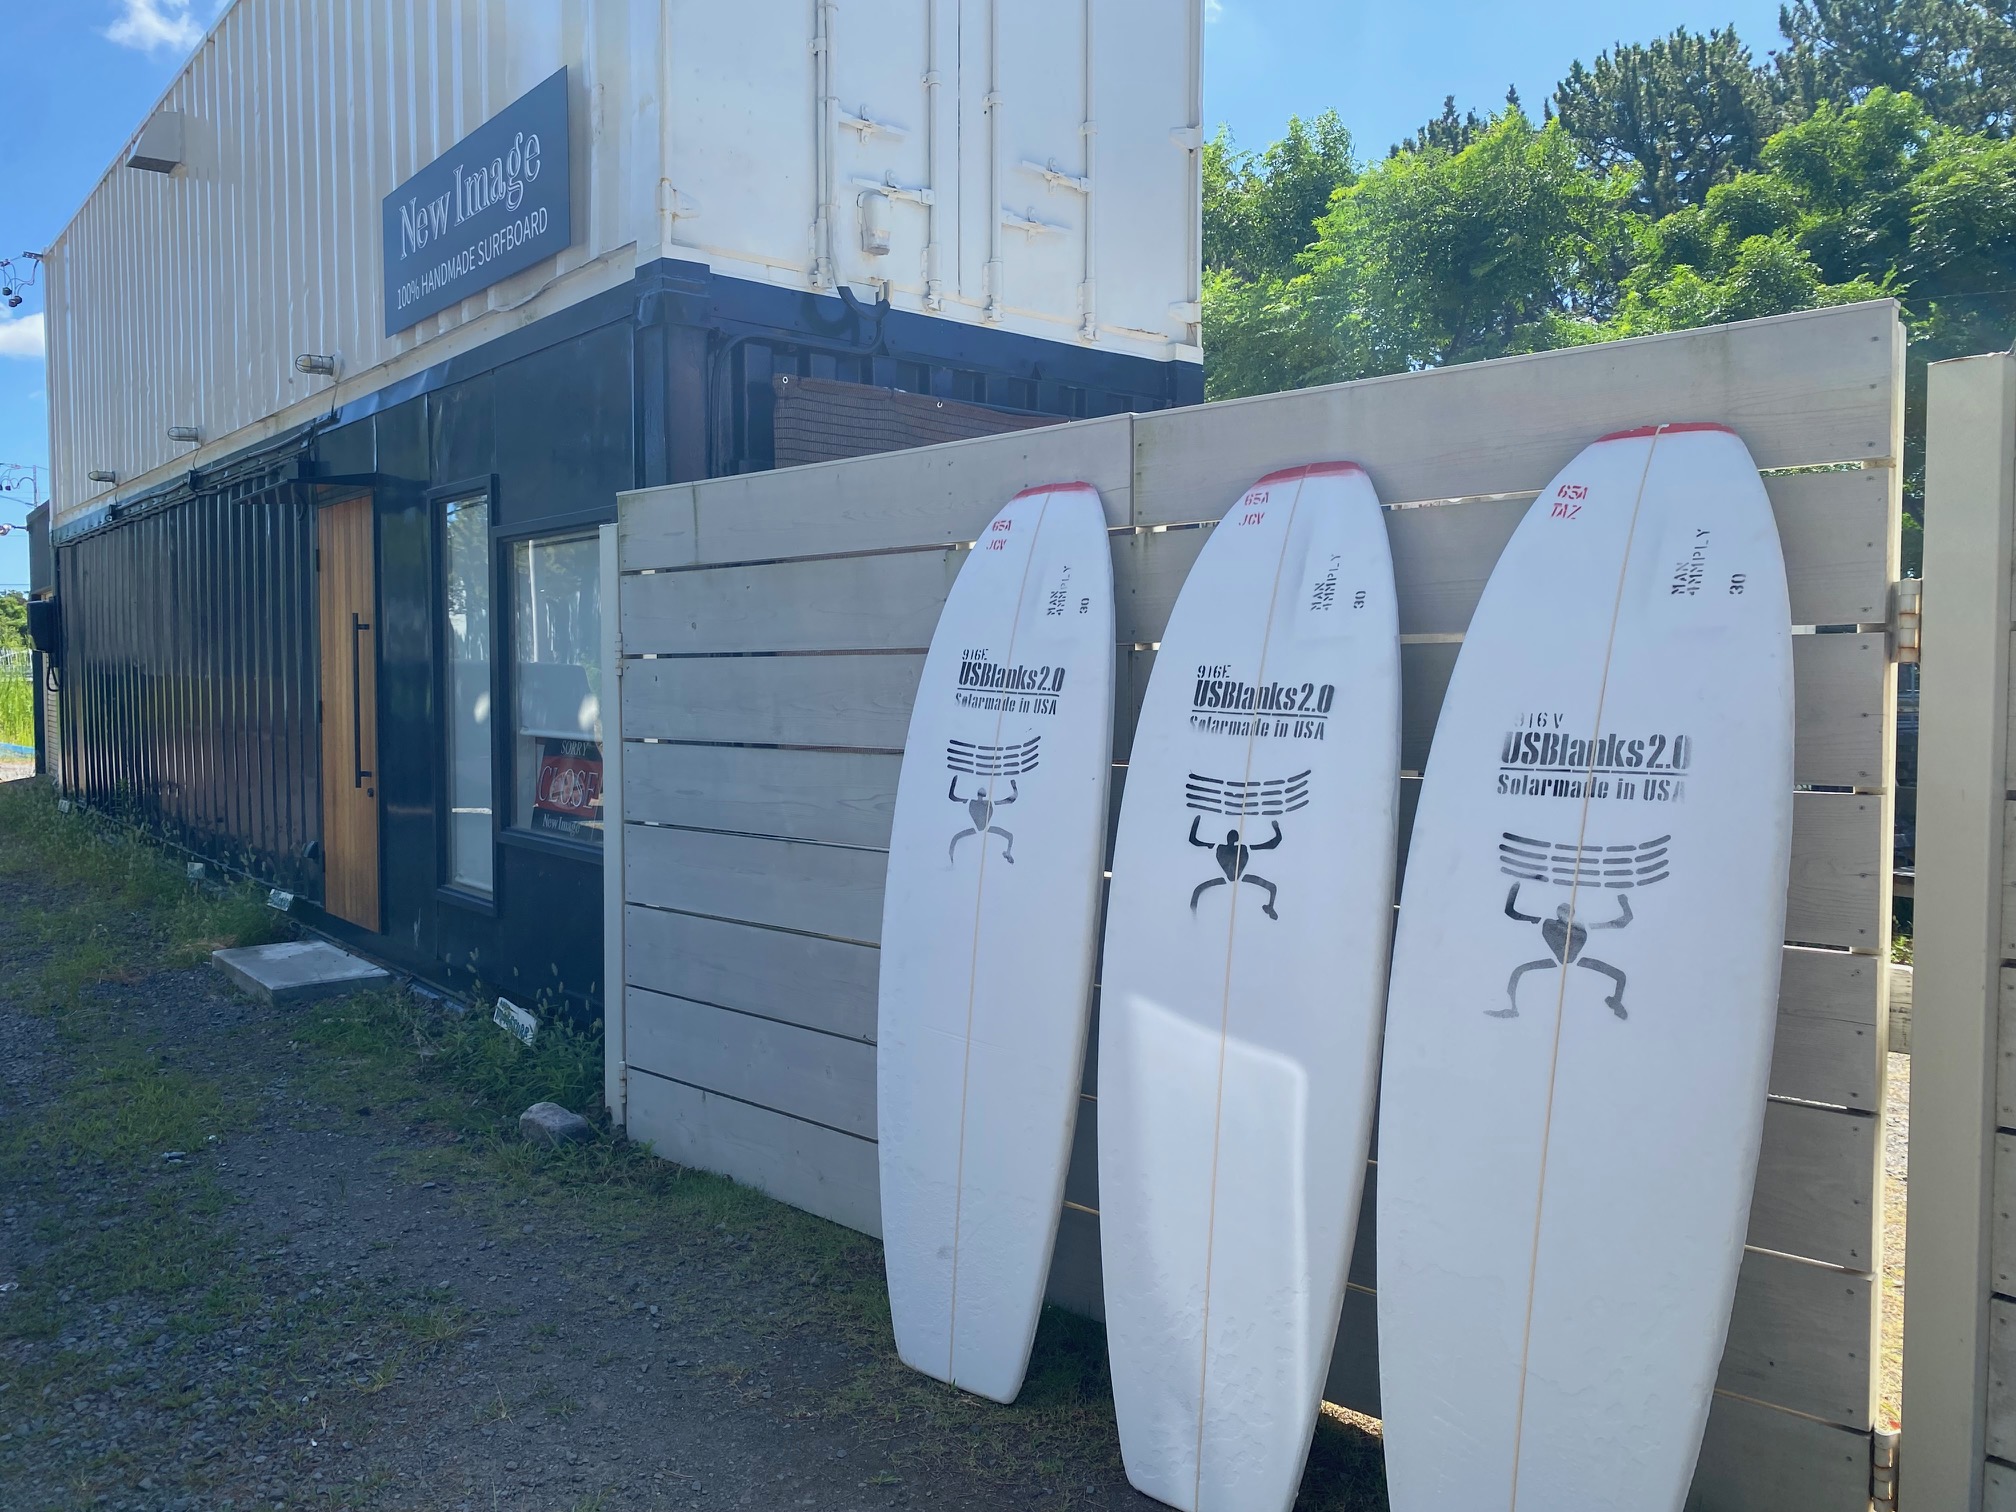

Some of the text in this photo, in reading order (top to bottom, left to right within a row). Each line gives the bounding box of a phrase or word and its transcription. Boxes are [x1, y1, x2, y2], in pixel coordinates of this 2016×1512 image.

[399, 131, 541, 261] New Image
[397, 206, 549, 311] 100% HANDMADE SURFBOARD
[1729, 573, 1746, 595] 30
[1079, 597, 1090, 614] 30
[1353, 590, 1366, 609] 30
[958, 661, 1066, 692] USBlanks2.0
[954, 692, 1057, 716] Solarmade in USA
[1193, 679, 1335, 713] USBlanks2.0
[1189, 715, 1325, 741] Solarmade in USA
[561, 740, 589, 756] SORRY
[1501, 731, 1693, 770] USBlanks2.0
[538, 766, 599, 809] CLOSE
[1497, 774, 1686, 803] Solarmade in USA
[543, 813, 581, 837] New Image
